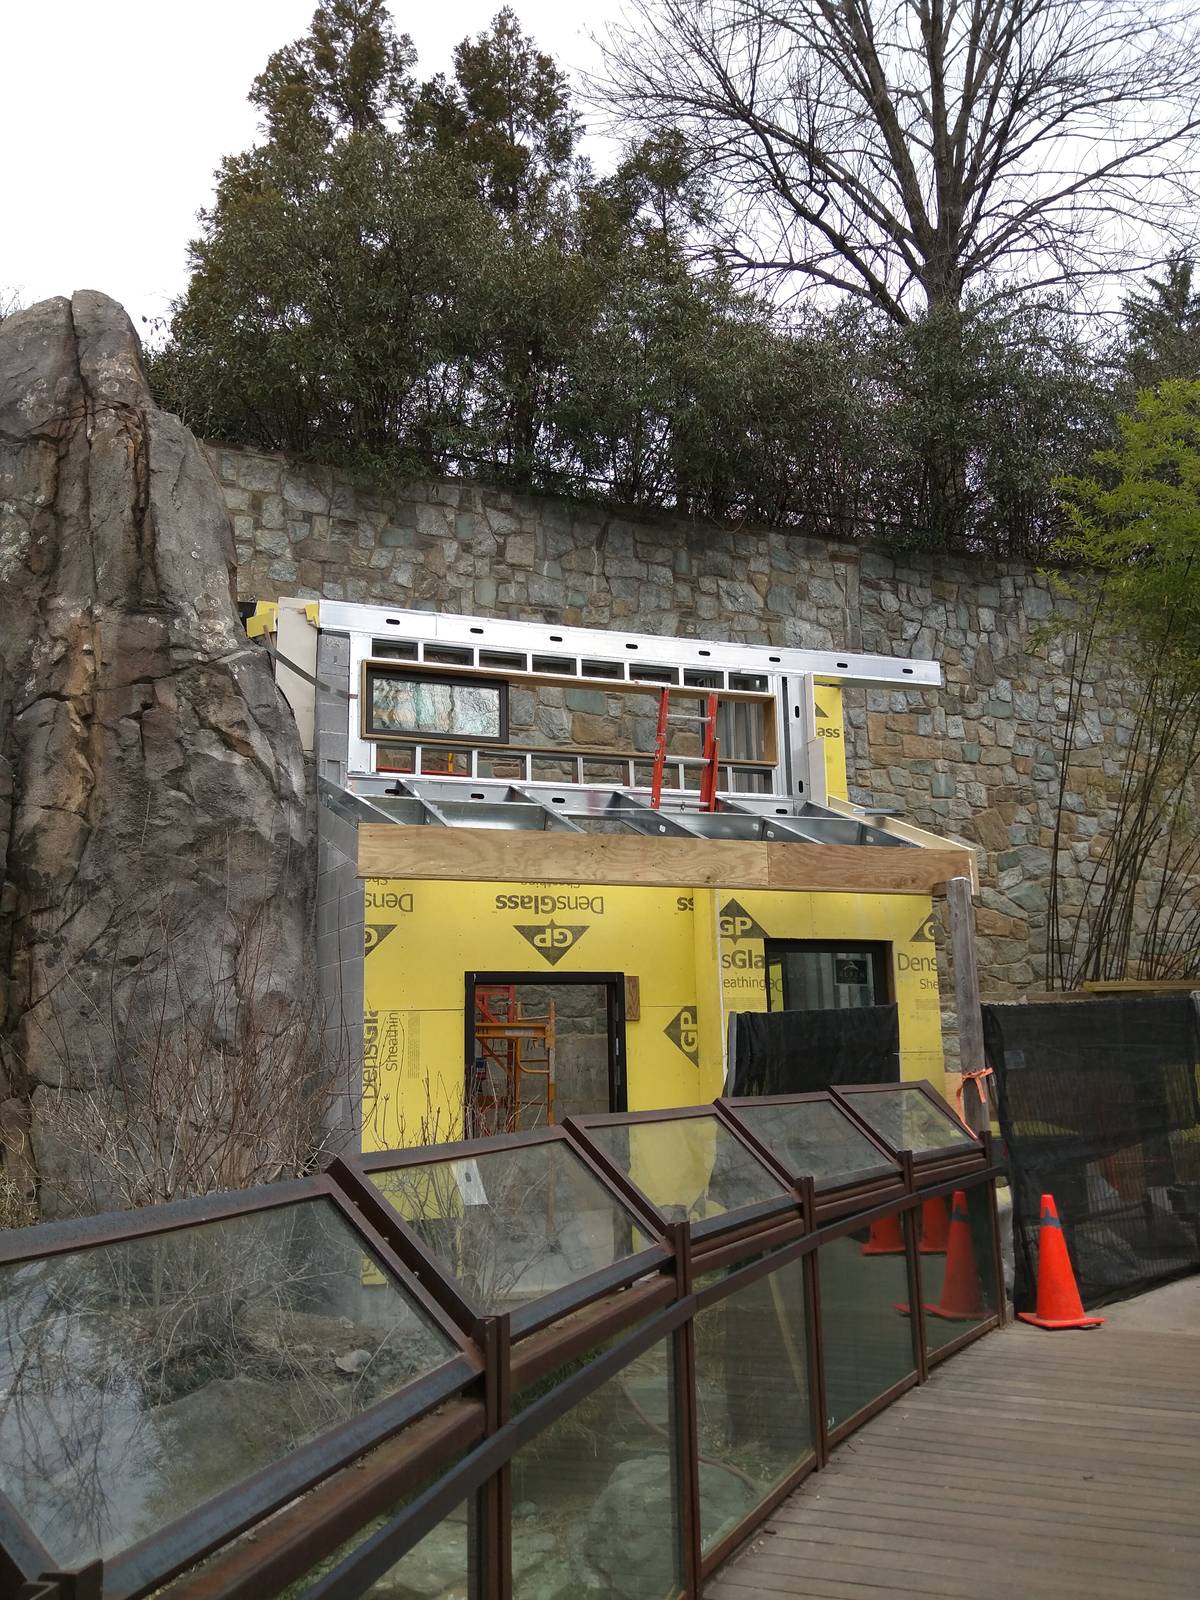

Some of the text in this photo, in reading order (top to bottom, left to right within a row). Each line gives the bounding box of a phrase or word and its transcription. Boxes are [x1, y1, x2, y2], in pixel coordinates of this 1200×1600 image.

[495, 894, 604, 915] DensGlass
[720, 916, 753, 936] GP
[533, 928, 574, 948] GP
[680, 1011, 698, 1053] GP
